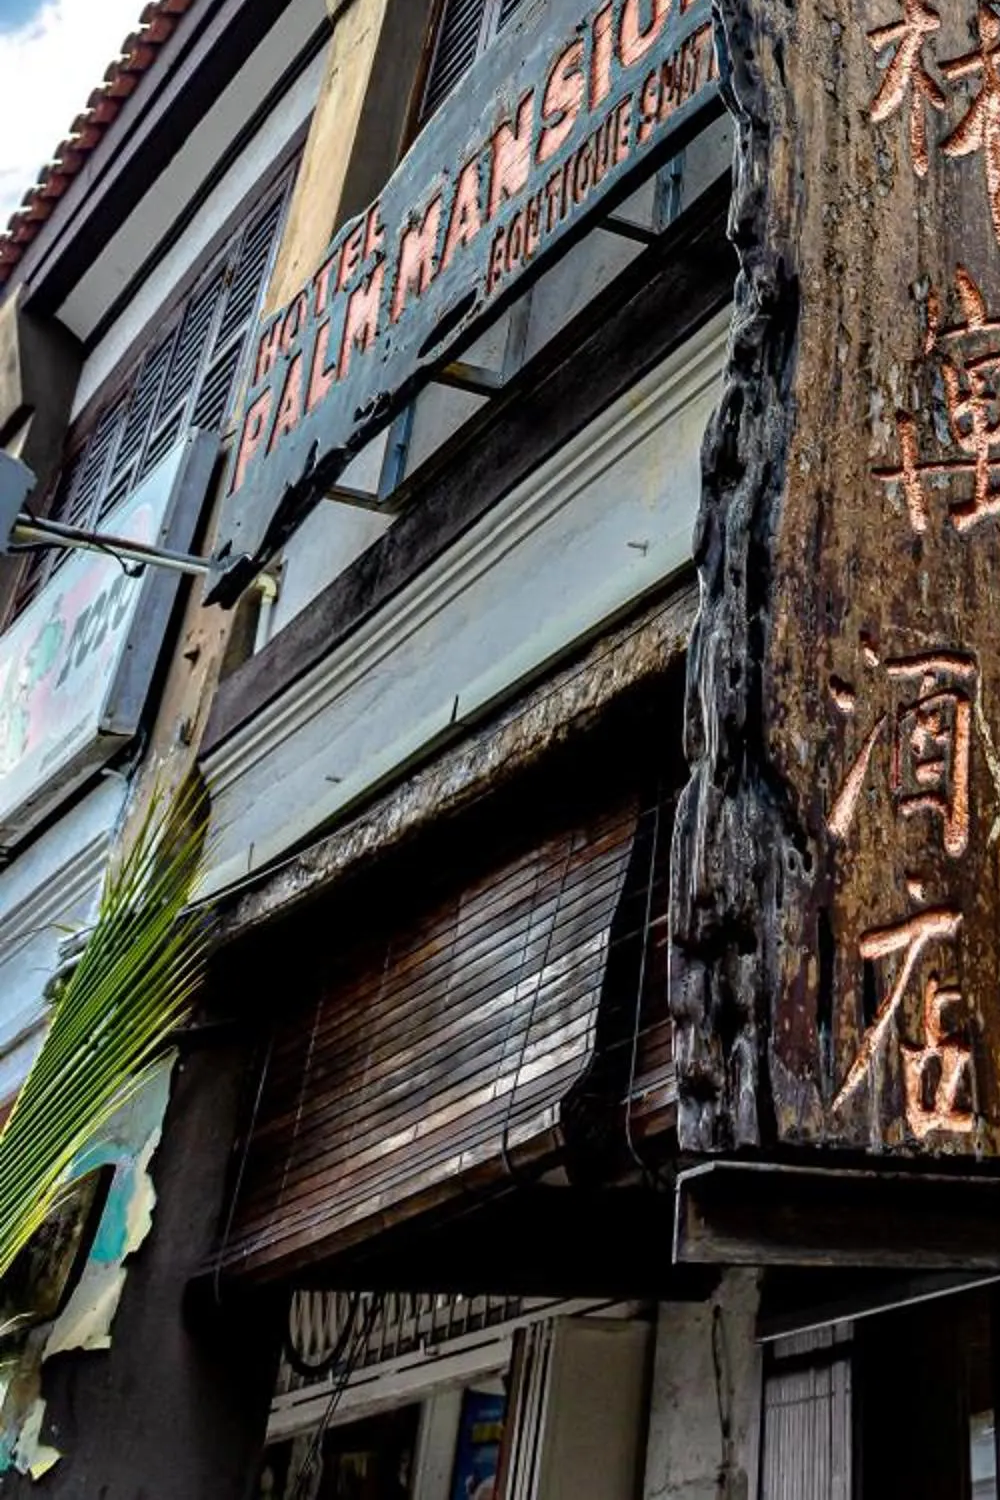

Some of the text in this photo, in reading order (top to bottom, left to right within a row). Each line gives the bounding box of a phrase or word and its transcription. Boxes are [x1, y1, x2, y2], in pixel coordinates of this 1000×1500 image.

[252, 201, 386, 388] HOTEL
[484, 90, 636, 296] BOUTIQUE
[226, 251, 387, 498] PALM
[828, 638, 977, 1136] 酒店
